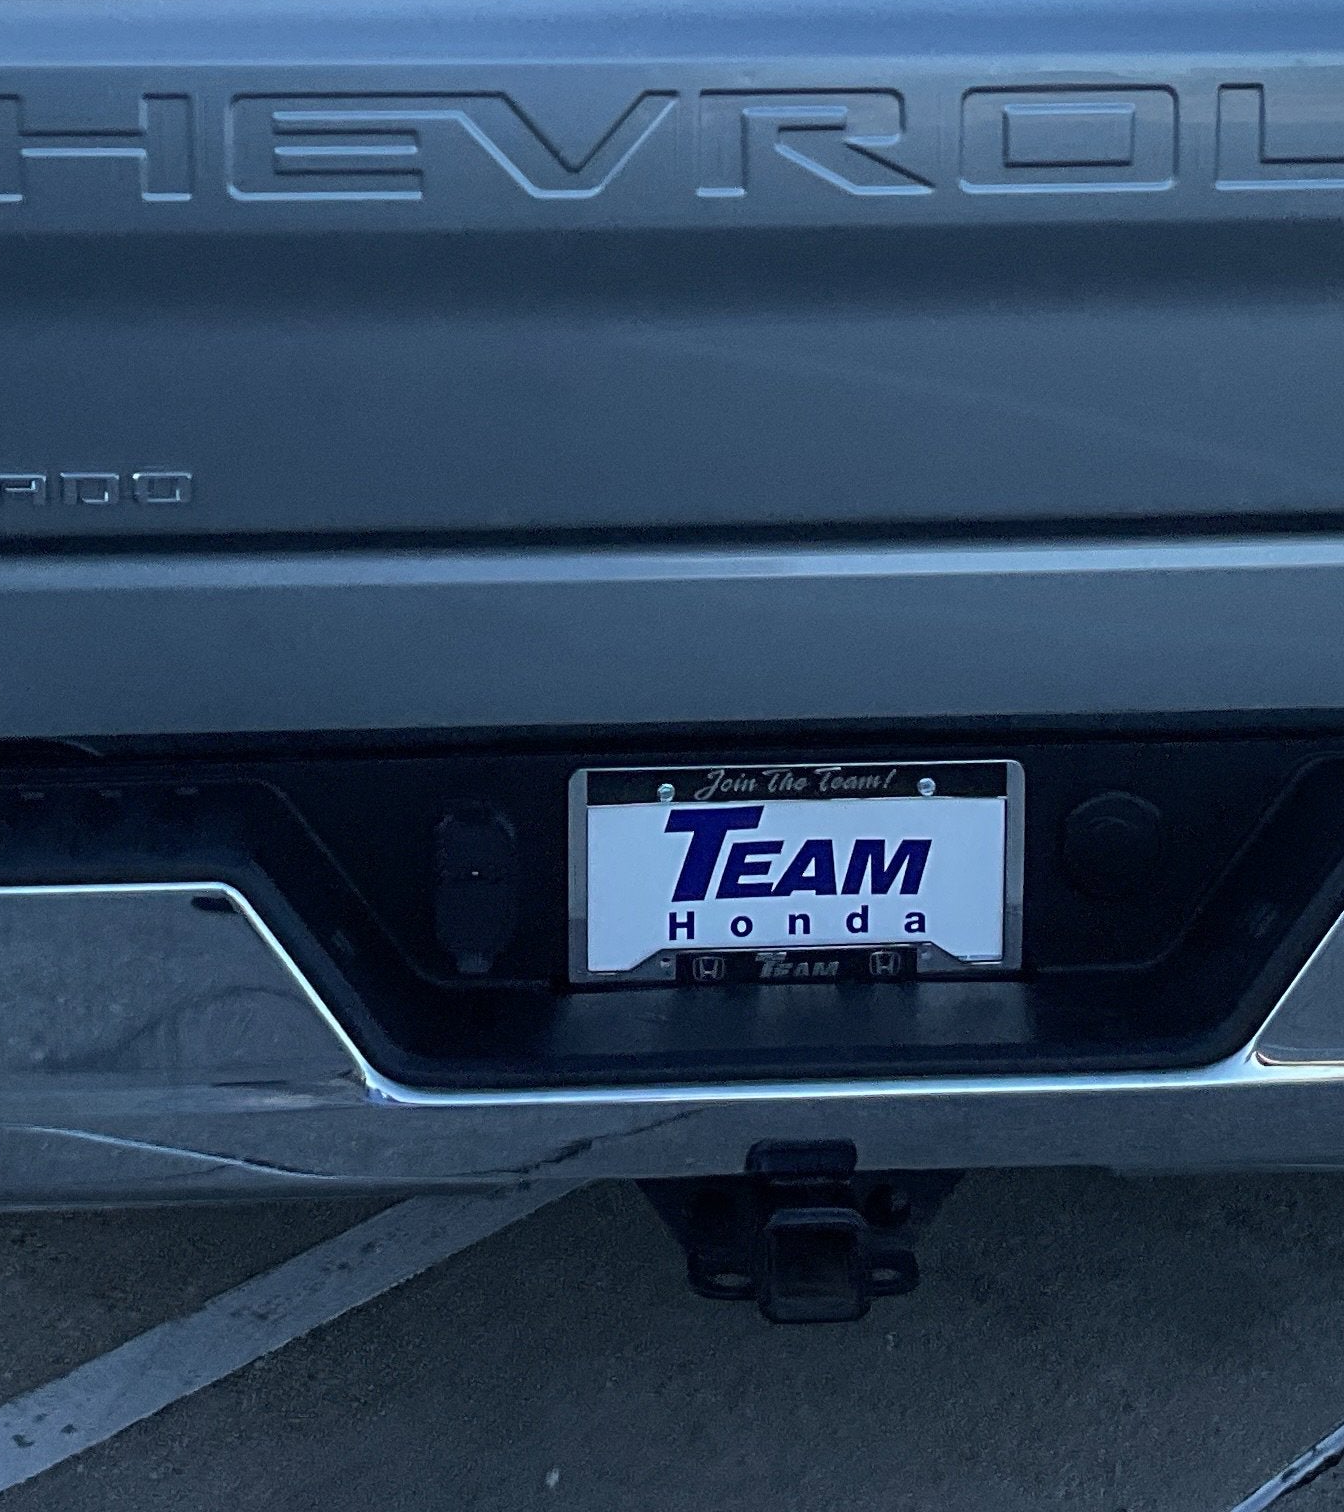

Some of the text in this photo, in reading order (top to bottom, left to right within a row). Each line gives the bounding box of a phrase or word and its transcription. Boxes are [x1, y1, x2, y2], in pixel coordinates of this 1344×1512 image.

[694, 766, 897, 801] Join The Team!
[664, 805, 933, 903] TEAM
[668, 905, 927, 941] Honda
[756, 952, 840, 979] TEAM
